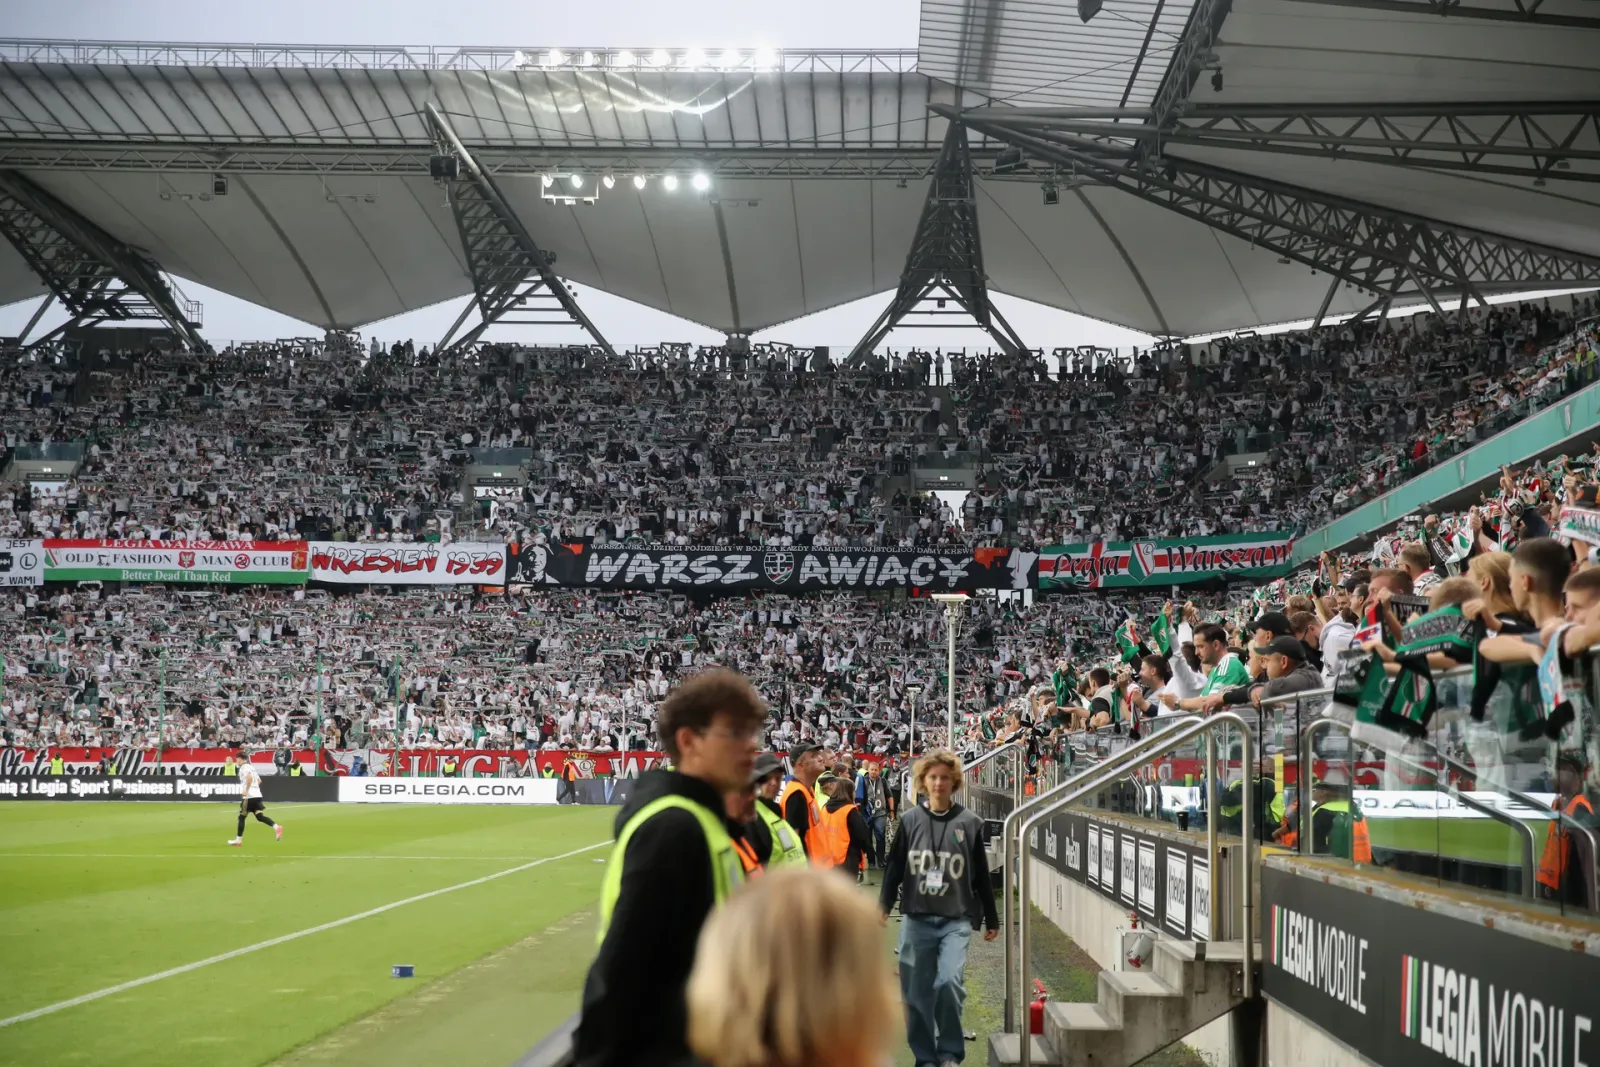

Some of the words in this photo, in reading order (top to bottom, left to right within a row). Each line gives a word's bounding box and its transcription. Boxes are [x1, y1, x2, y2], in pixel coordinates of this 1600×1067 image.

[5, 540, 33, 549] JEST
[101, 539, 155, 548] LEGIA
[65, 552, 94, 564] OLD
[113, 553, 172, 564] FASHION
[202, 555, 233, 566] MAN
[253, 555, 289, 567] CLUB
[446, 551, 503, 575] 1939
[9, 576, 36, 584] WAMI
[122, 571, 152, 580] Better
[155, 572, 180, 581] Dead
[183, 572, 209, 581] Than
[212, 573, 231, 582] Red
[21, 782, 28, 794] z
[31, 779, 68, 797] Legia
[71, 779, 110, 797] Sport
[112, 779, 173, 794] Business
[365, 784, 525, 796] SBP.LEGIA.COM
[908, 849, 965, 880] FOTO
[1282, 908, 1315, 986] LEGIA
[1316, 922, 1369, 1015] MOBILE
[1421, 960, 1482, 1067] LEGIA
[1487, 983, 1592, 1067] MOBILE
